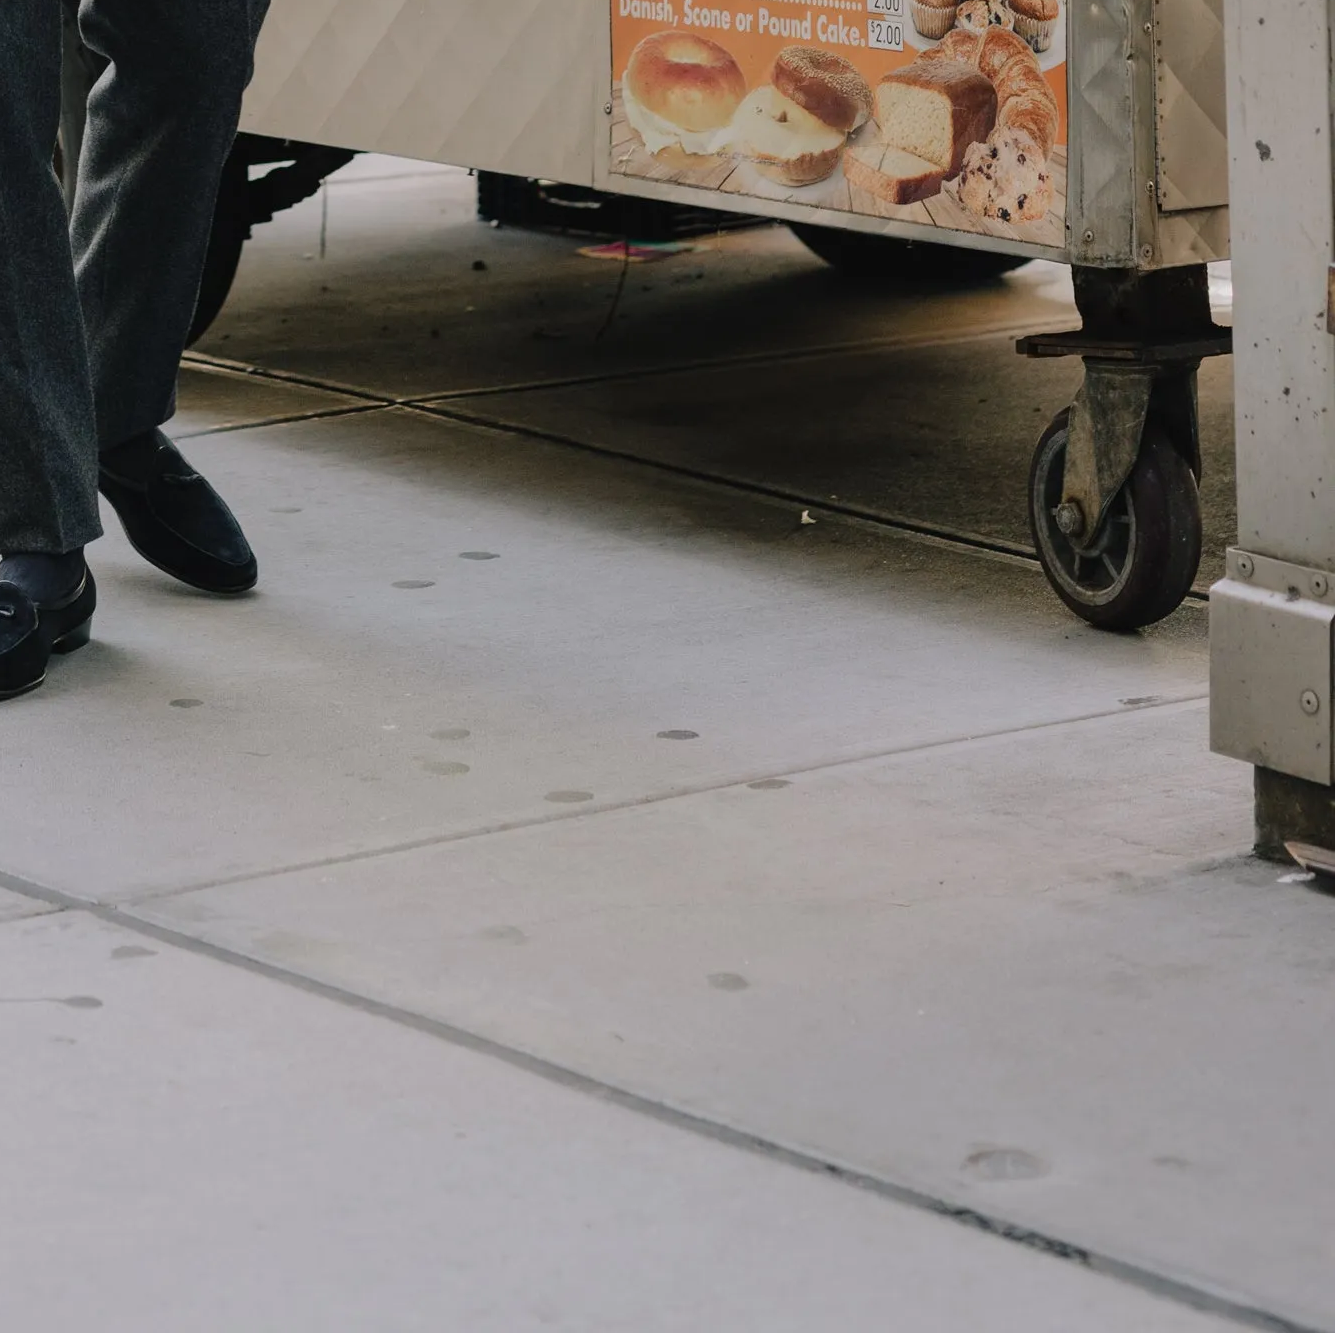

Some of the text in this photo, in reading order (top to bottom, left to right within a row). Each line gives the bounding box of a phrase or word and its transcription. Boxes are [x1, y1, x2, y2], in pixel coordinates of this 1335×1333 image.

[736, 12, 753, 31] or
[758, 8, 812, 41] Pound
[817, 16, 866, 47] Cake.
[871, 22, 901, 46] $2.00
